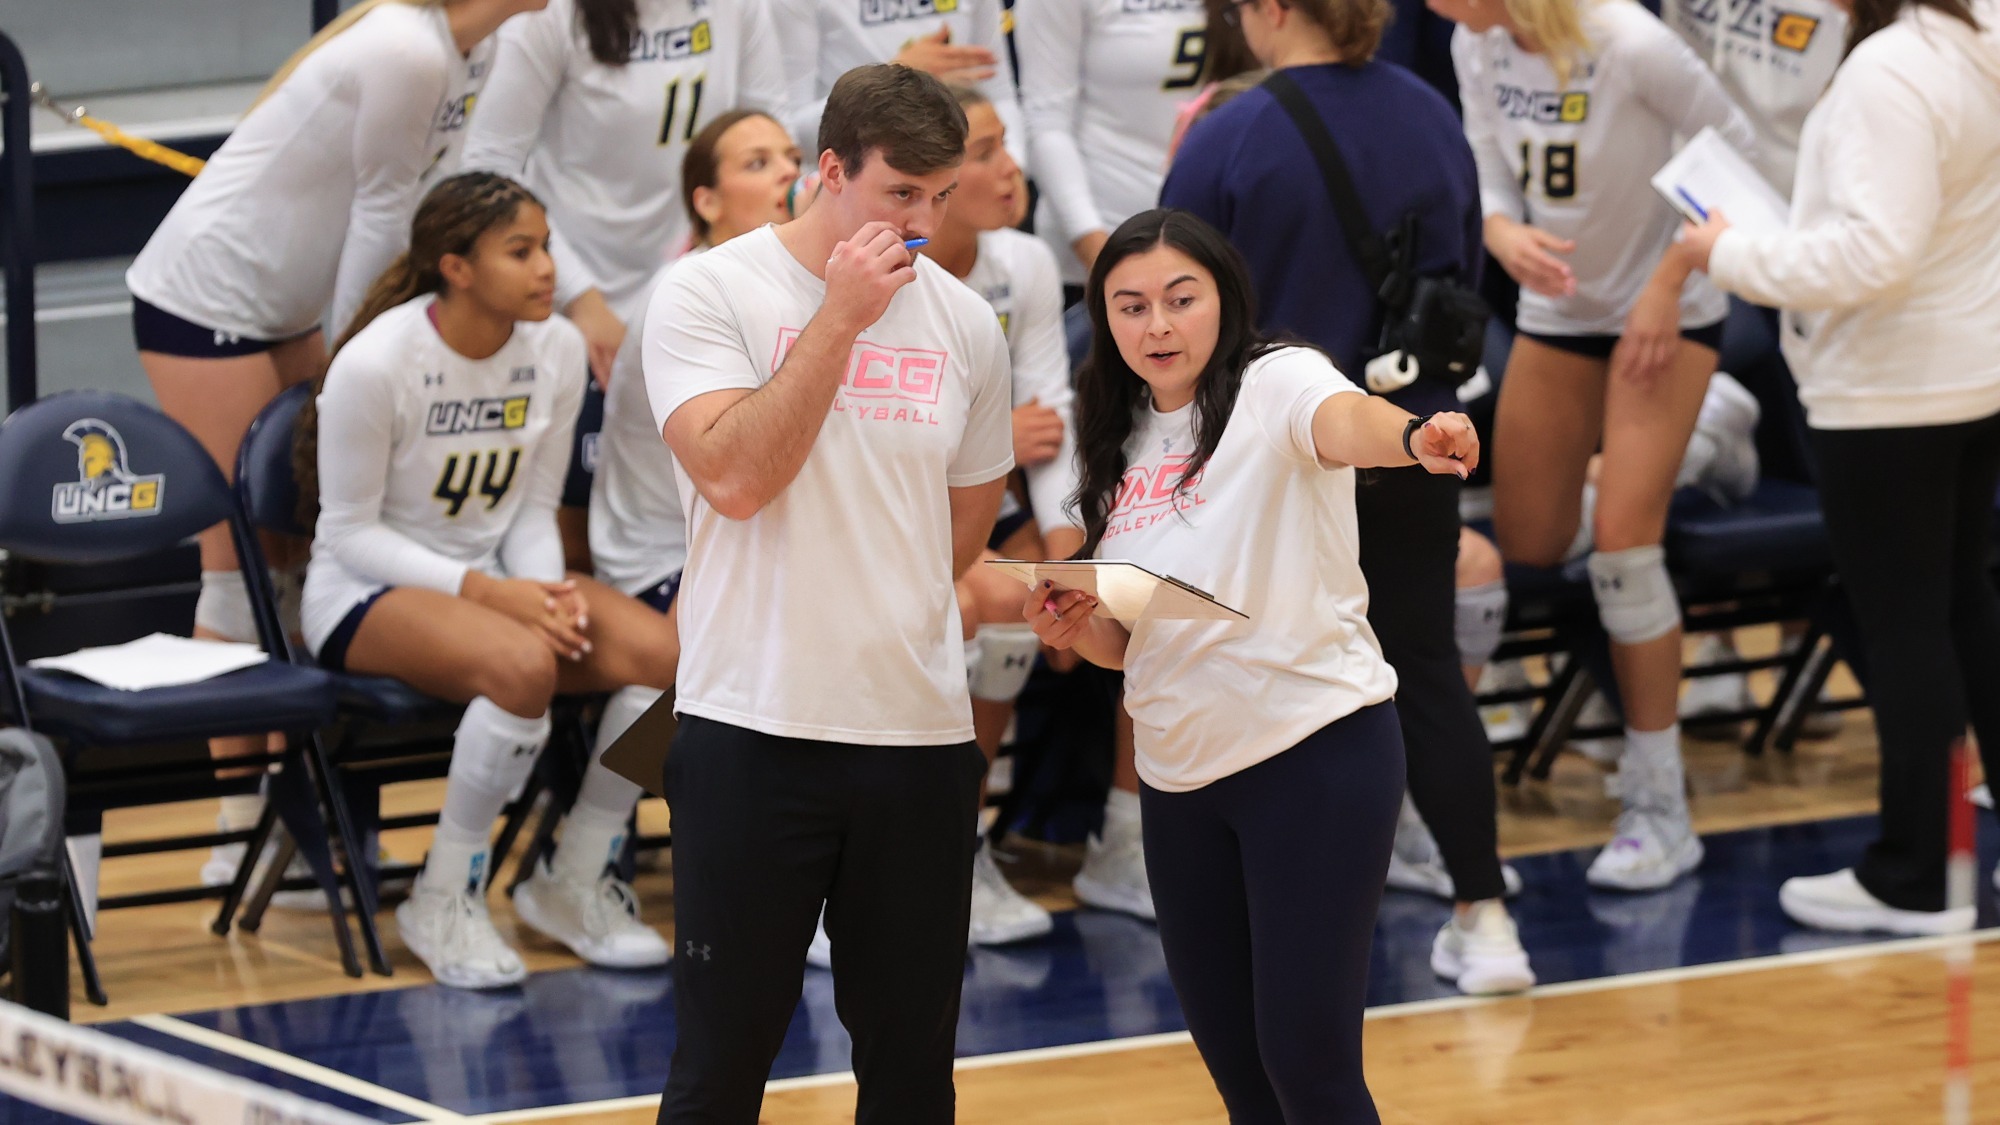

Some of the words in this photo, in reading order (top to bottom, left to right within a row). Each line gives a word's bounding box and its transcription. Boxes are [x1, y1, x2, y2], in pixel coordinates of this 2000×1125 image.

[1161, 28, 1210, 91] 9
[657, 73, 706, 146] 11
[1519, 139, 1580, 200] 18
[426, 395, 531, 435] UNCG
[55, 478, 161, 519] UNCG
[432, 448, 522, 518] 44
